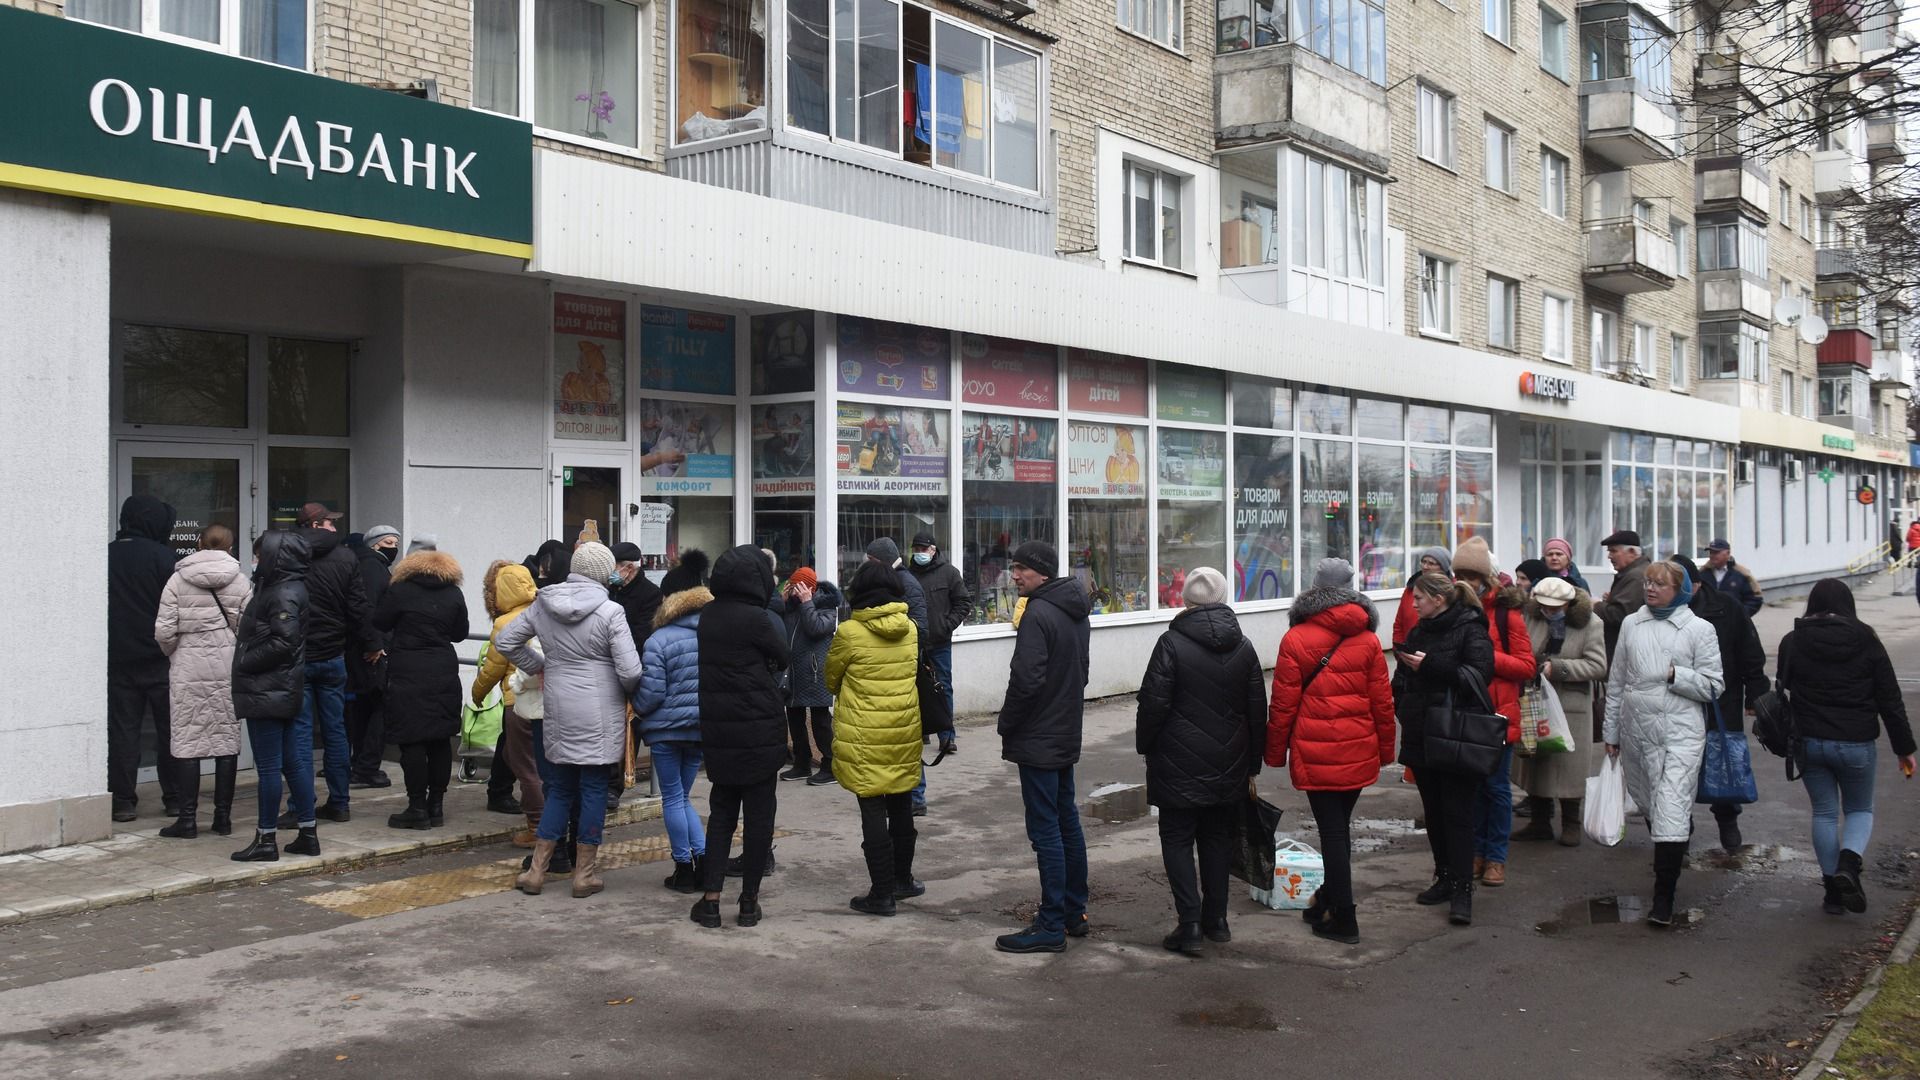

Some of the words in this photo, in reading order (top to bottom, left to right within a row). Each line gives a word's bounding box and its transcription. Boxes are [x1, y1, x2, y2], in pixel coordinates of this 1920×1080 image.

[90, 78, 480, 198] ОЩАДБАНК
[1089, 384, 1120, 402] дітей
[1535, 374, 1559, 398] MEGA
[556, 421, 592, 433] ОПТОВІ
[595, 423, 618, 436] ЦІНИ
[1068, 425, 1109, 444] ОПТОВІ
[1068, 457, 1096, 476] ЦІНИ
[656, 480, 712, 492] КОМФОРТ
[755, 479, 816, 495] НАДІЙНІСТЬ
[837, 478, 880, 491] ВЕЛИКИЙ
[884, 481, 942, 491] АСОРТИМЕНТ
[1243, 487, 1281, 508] товари
[1303, 489, 1349, 507] аксесуари
[1366, 491, 1394, 508] взуття
[1236, 509, 1258, 529] для
[1260, 509, 1288, 529] дому
